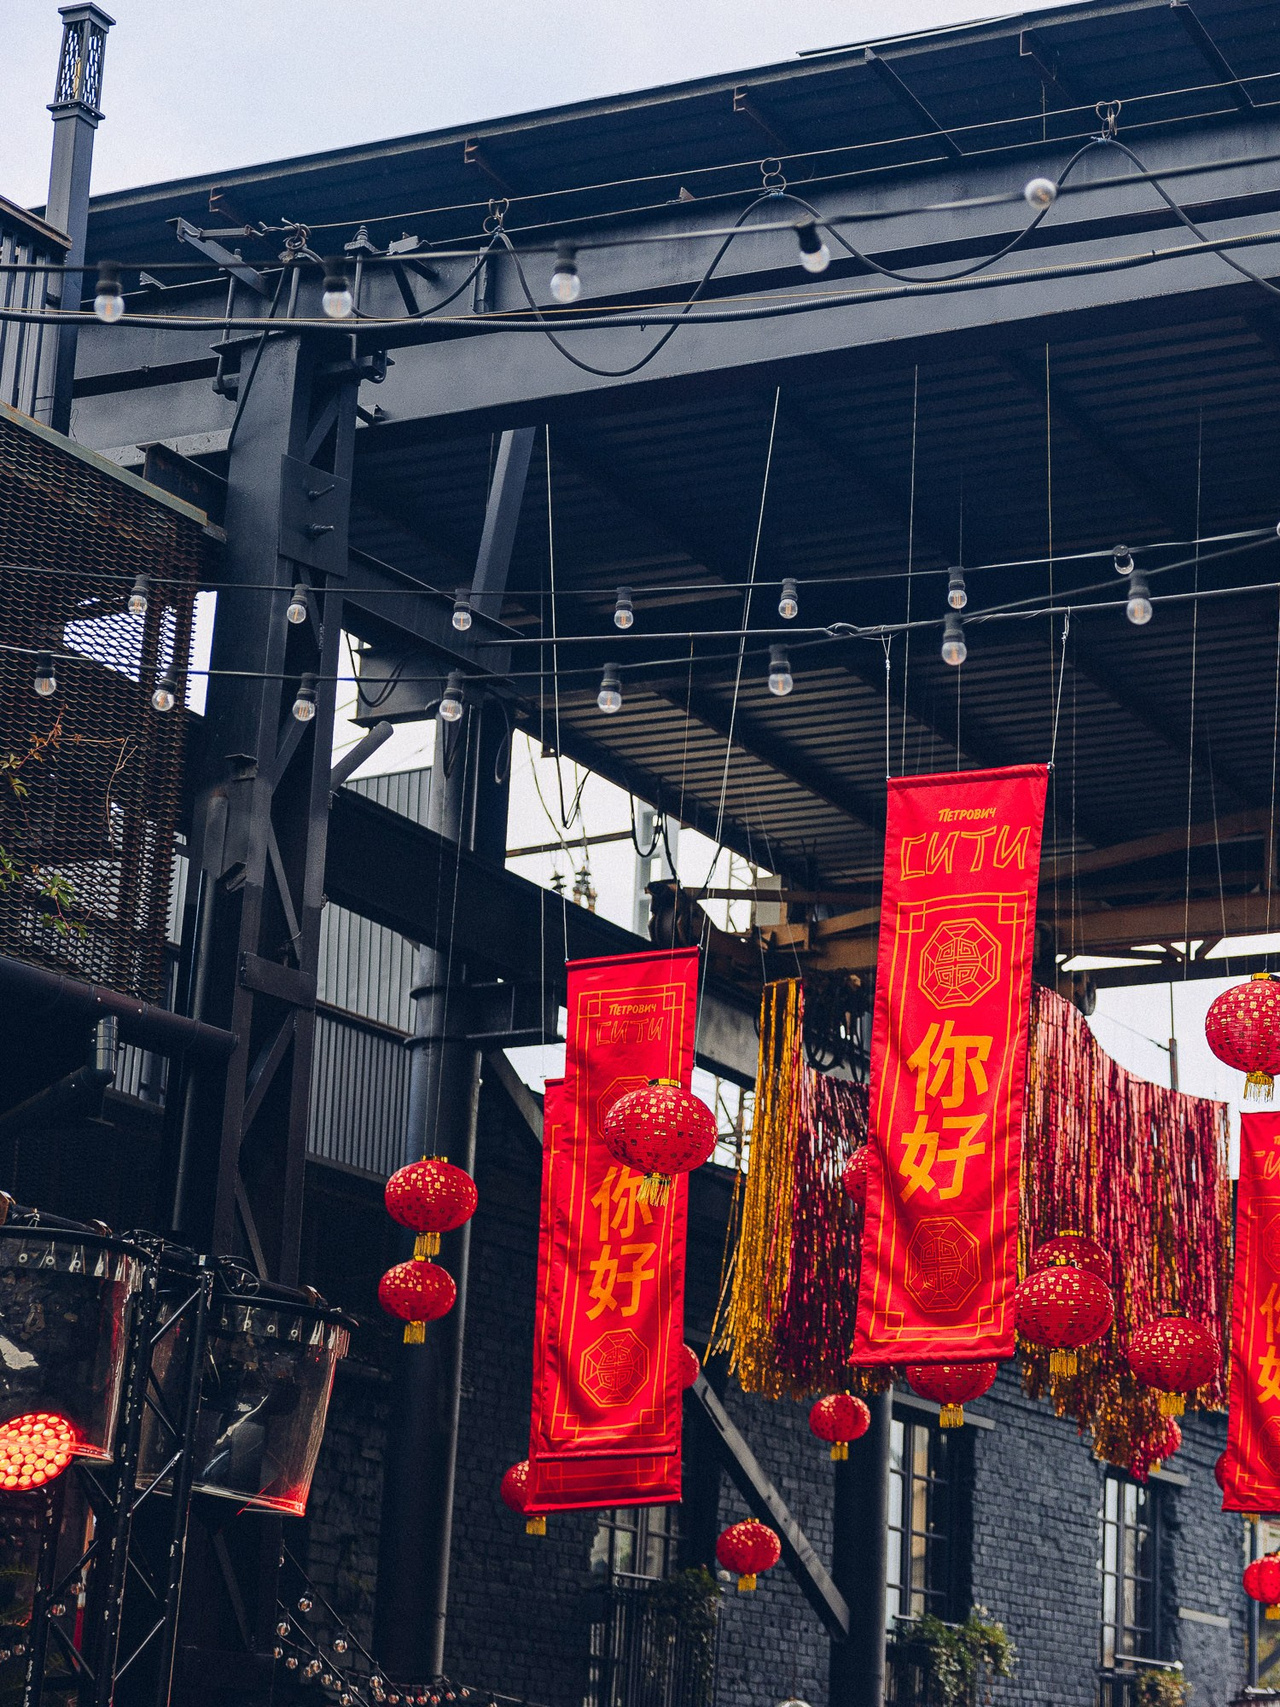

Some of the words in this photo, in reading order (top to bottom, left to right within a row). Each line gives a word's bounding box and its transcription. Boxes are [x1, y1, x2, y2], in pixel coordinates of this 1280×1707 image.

[938, 807, 997, 822] ПЕТРОВИЧ
[900, 825, 1032, 881] СИТИ
[608, 1003, 657, 1016] ПЕТРОВИЧ
[596, 1017, 664, 1046] СИТИ
[899, 1020, 994, 1203] 你好
[585, 1164, 657, 1321] 你好
